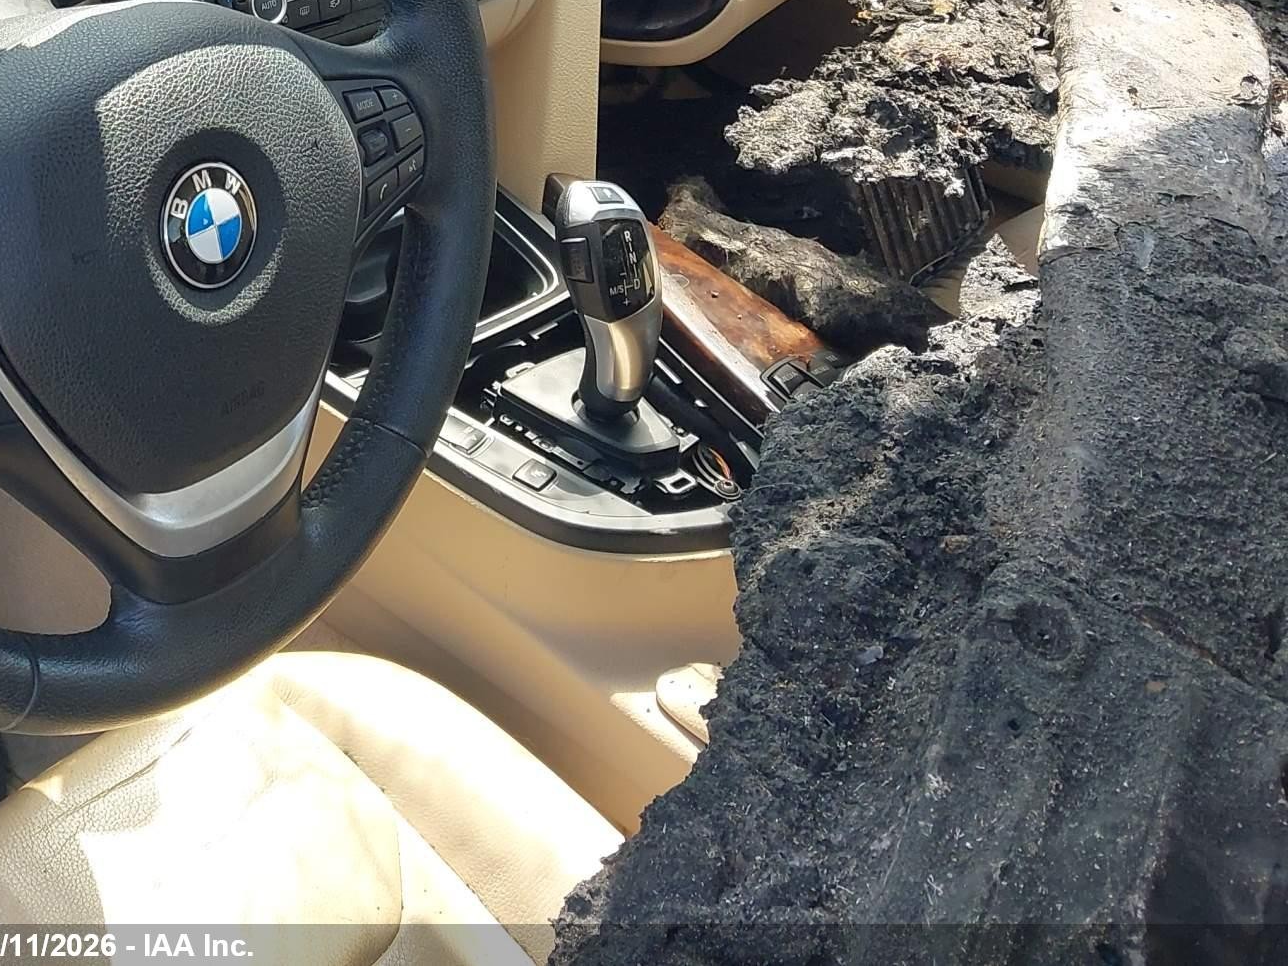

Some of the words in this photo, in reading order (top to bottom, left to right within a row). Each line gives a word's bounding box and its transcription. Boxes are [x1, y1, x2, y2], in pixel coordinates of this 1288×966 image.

[356, 98, 374, 111] MODE
[170, 169, 241, 220] BMW
[624, 230, 632, 242] R
[629, 251, 637, 264] N
[634, 278, 640, 290] D
[609, 285, 624, 296] M/S
